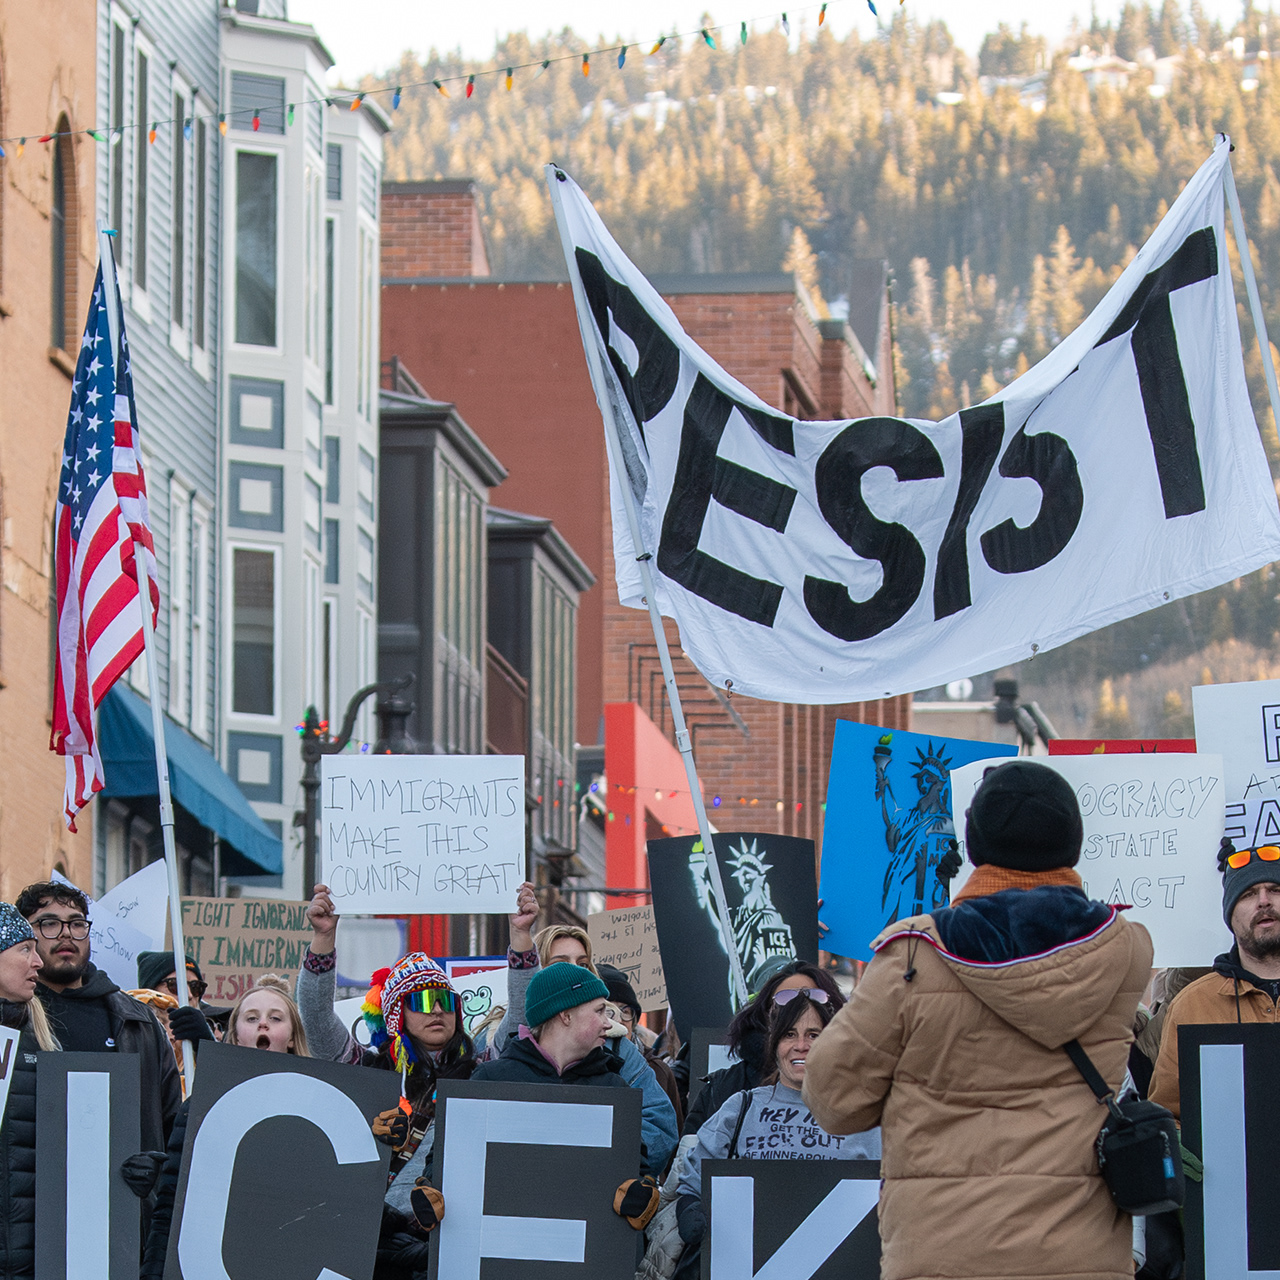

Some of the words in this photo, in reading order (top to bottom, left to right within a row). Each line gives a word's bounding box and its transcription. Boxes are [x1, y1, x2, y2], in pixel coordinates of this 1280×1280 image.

[324, 775, 519, 818] IMMIGRANTS
[329, 822, 402, 861] MAKE
[417, 823, 489, 857] THIS
[1083, 828, 1178, 860] STATE
[329, 861, 421, 898] COUNTRY
[181, 901, 235, 928] FIGHT
[105, 926, 134, 961] Snow
[768, 931, 787, 947] ICE
[759, 1106, 800, 1124] HEY
[770, 1123, 793, 1133] GET
[797, 1126, 820, 1136] THE
